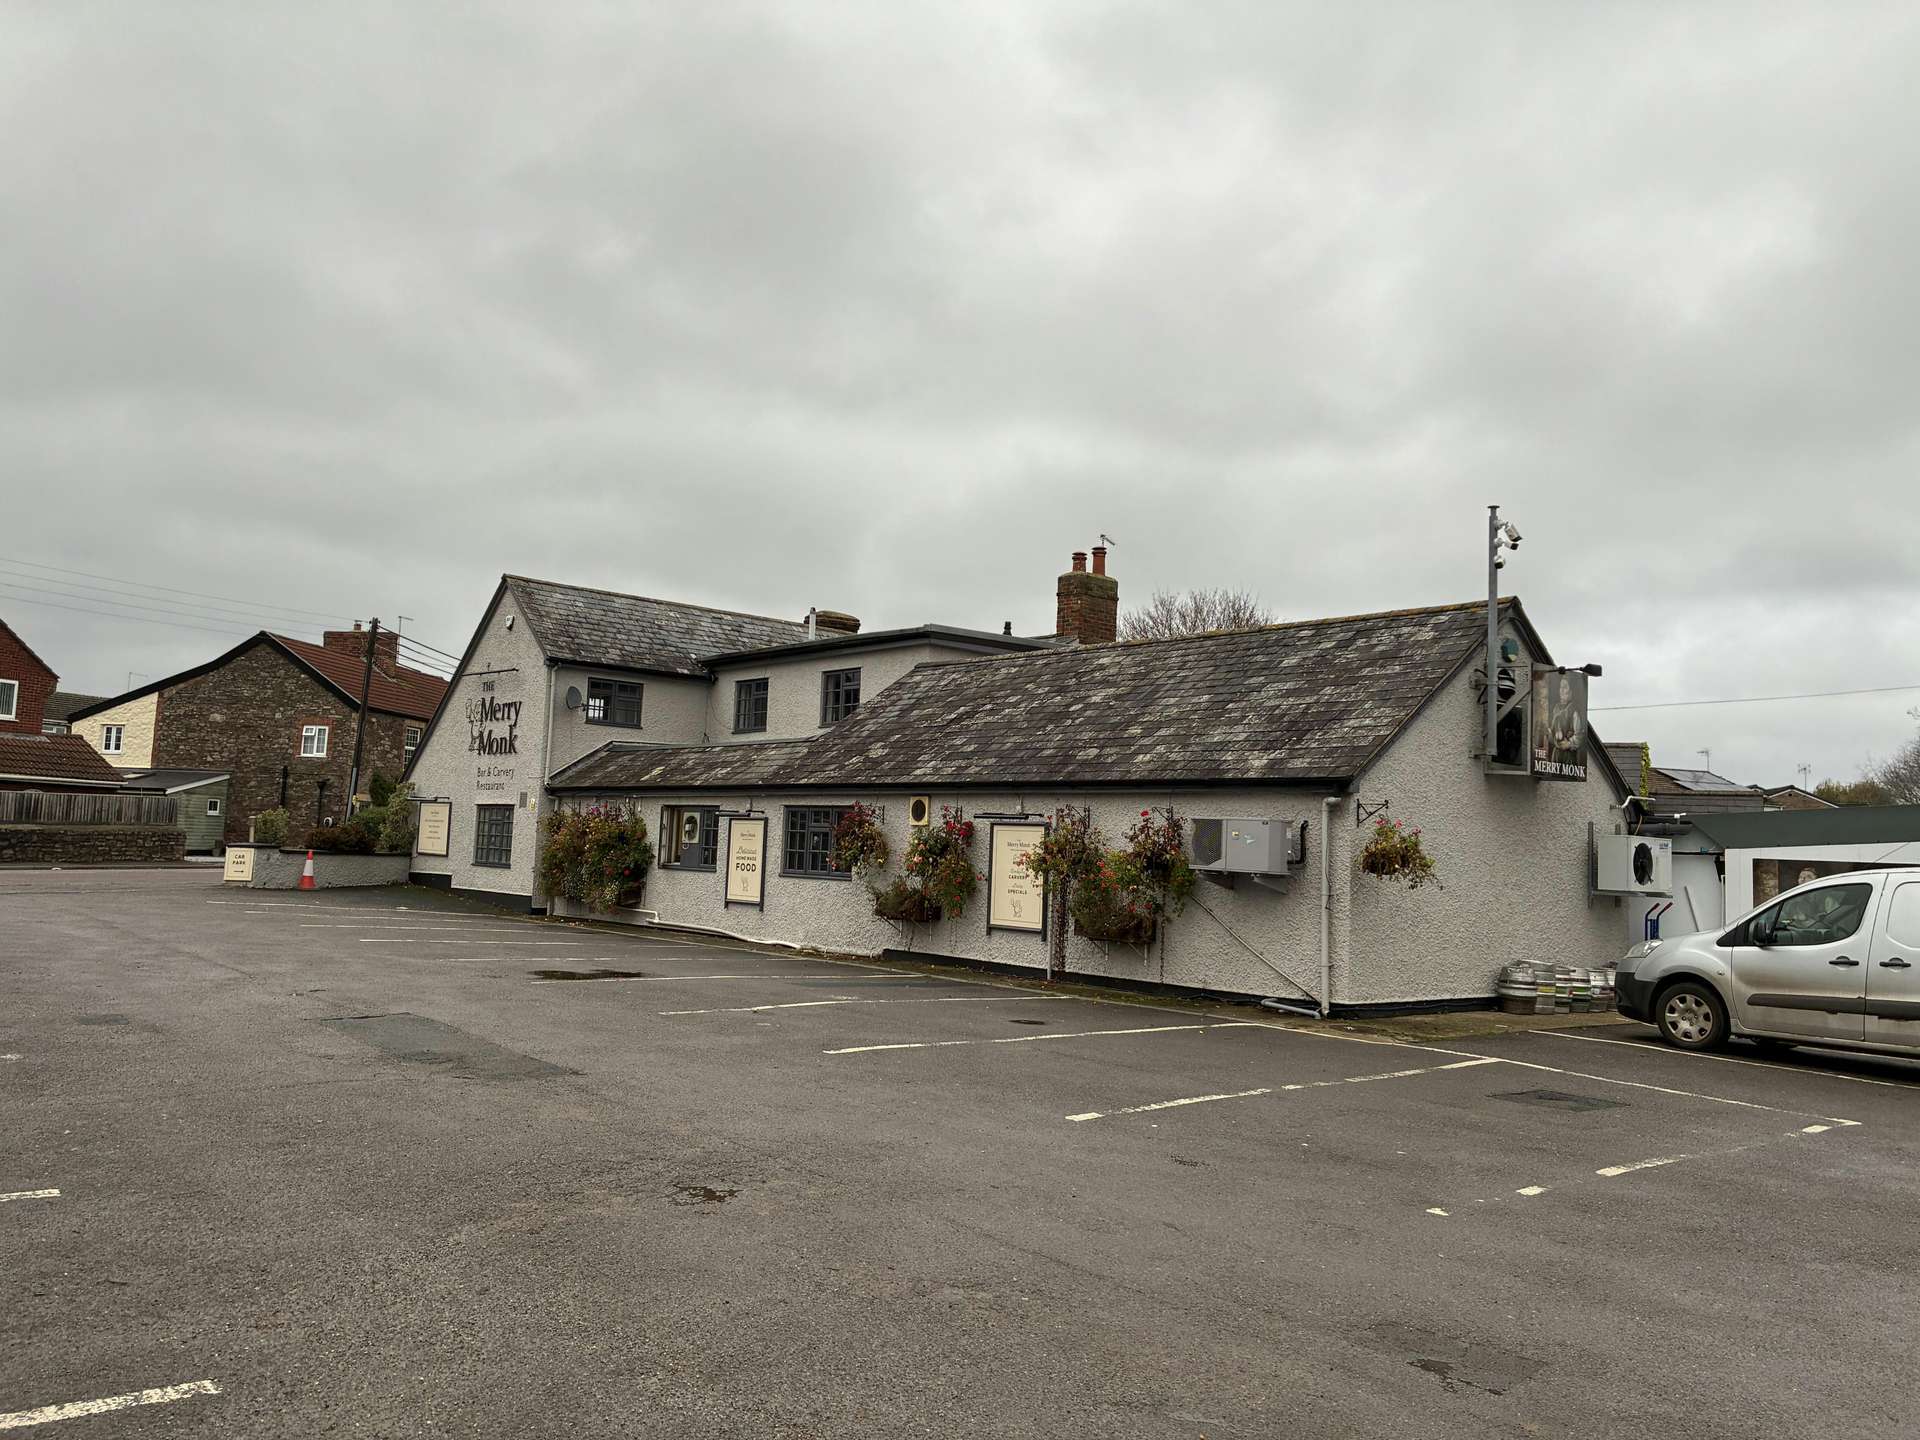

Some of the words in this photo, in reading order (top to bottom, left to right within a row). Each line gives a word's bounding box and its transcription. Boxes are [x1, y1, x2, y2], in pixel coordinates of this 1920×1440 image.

[482, 682, 495, 692] THE
[480, 696, 522, 727] Merry
[478, 724, 518, 756] Monk
[1535, 749, 1547, 759] THE
[493, 766, 515, 780] Carvery
[1534, 760, 1561, 774] MERRY
[1562, 763, 1586, 778] MONK
[736, 863, 757, 872] FOOD
